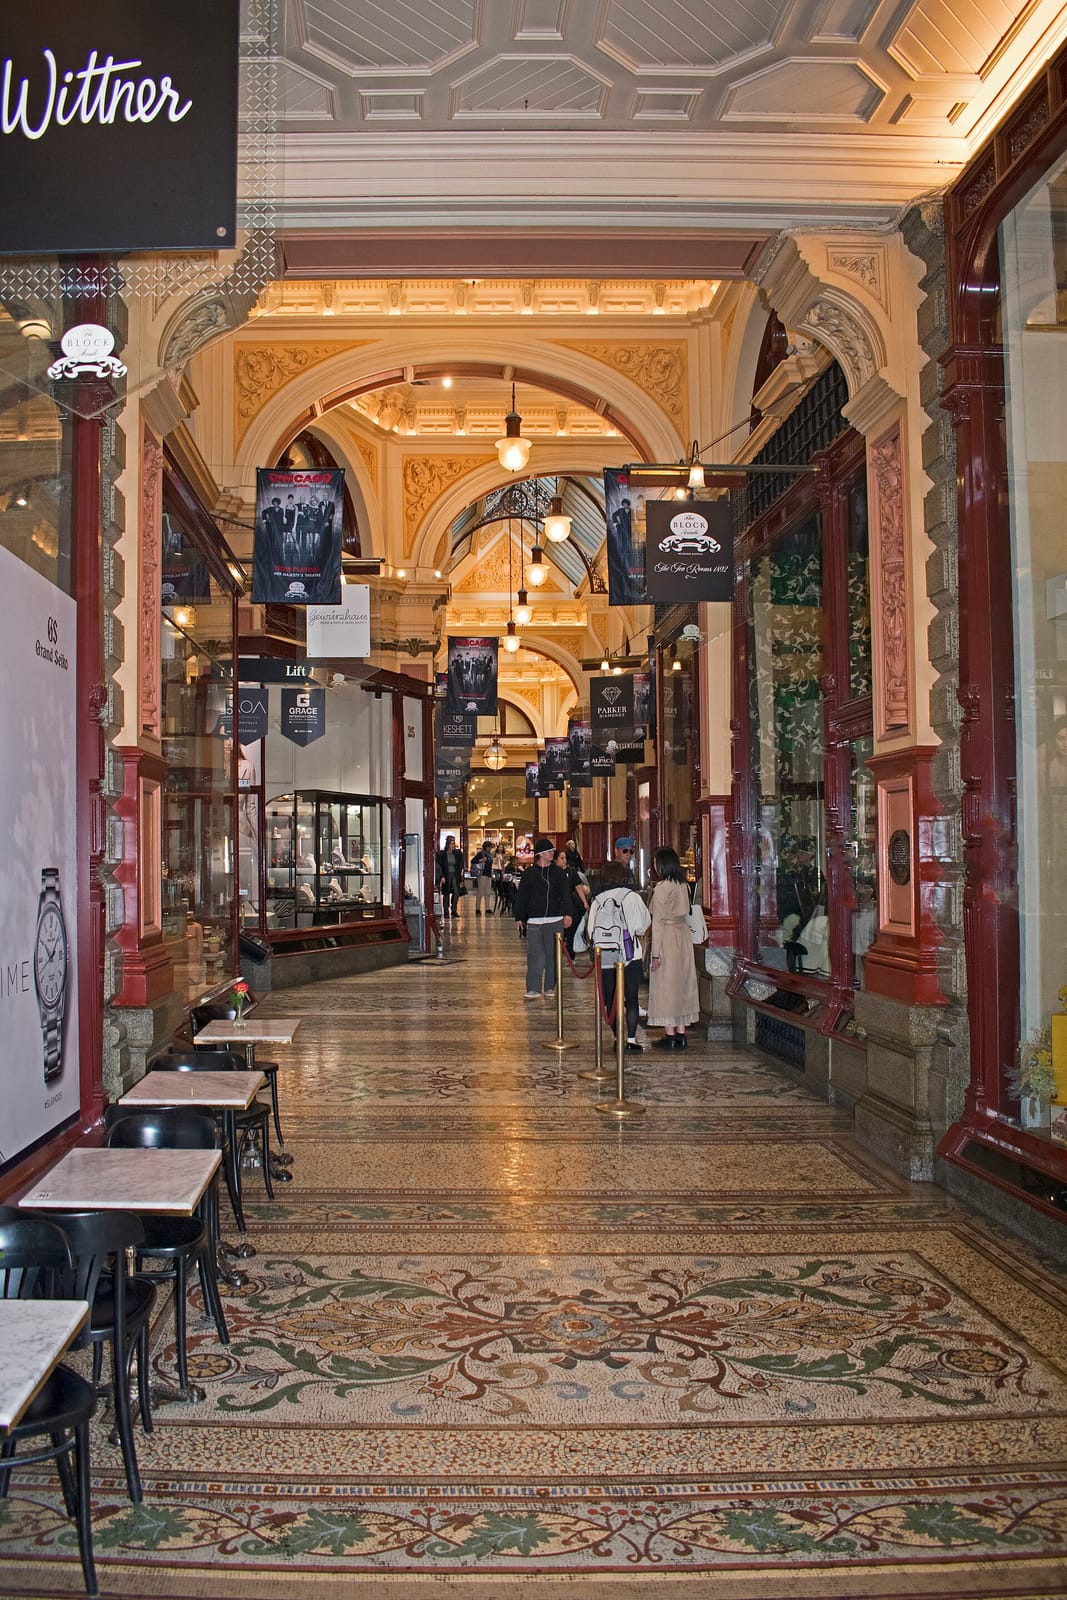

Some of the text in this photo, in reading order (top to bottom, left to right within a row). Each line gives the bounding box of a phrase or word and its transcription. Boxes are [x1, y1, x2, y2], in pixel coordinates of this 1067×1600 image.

[1, 48, 193, 140] Wittner
[67, 339, 110, 347] BLOCK
[712, 564, 729, 574] 1892
[47, 616, 58, 645] GS
[35, 640, 54, 663] Grand
[285, 665, 306, 677] Lift
[288, 707, 318, 715] GRACE
[597, 706, 627, 714] PARKER
[442, 724, 473, 734] KESHETT
